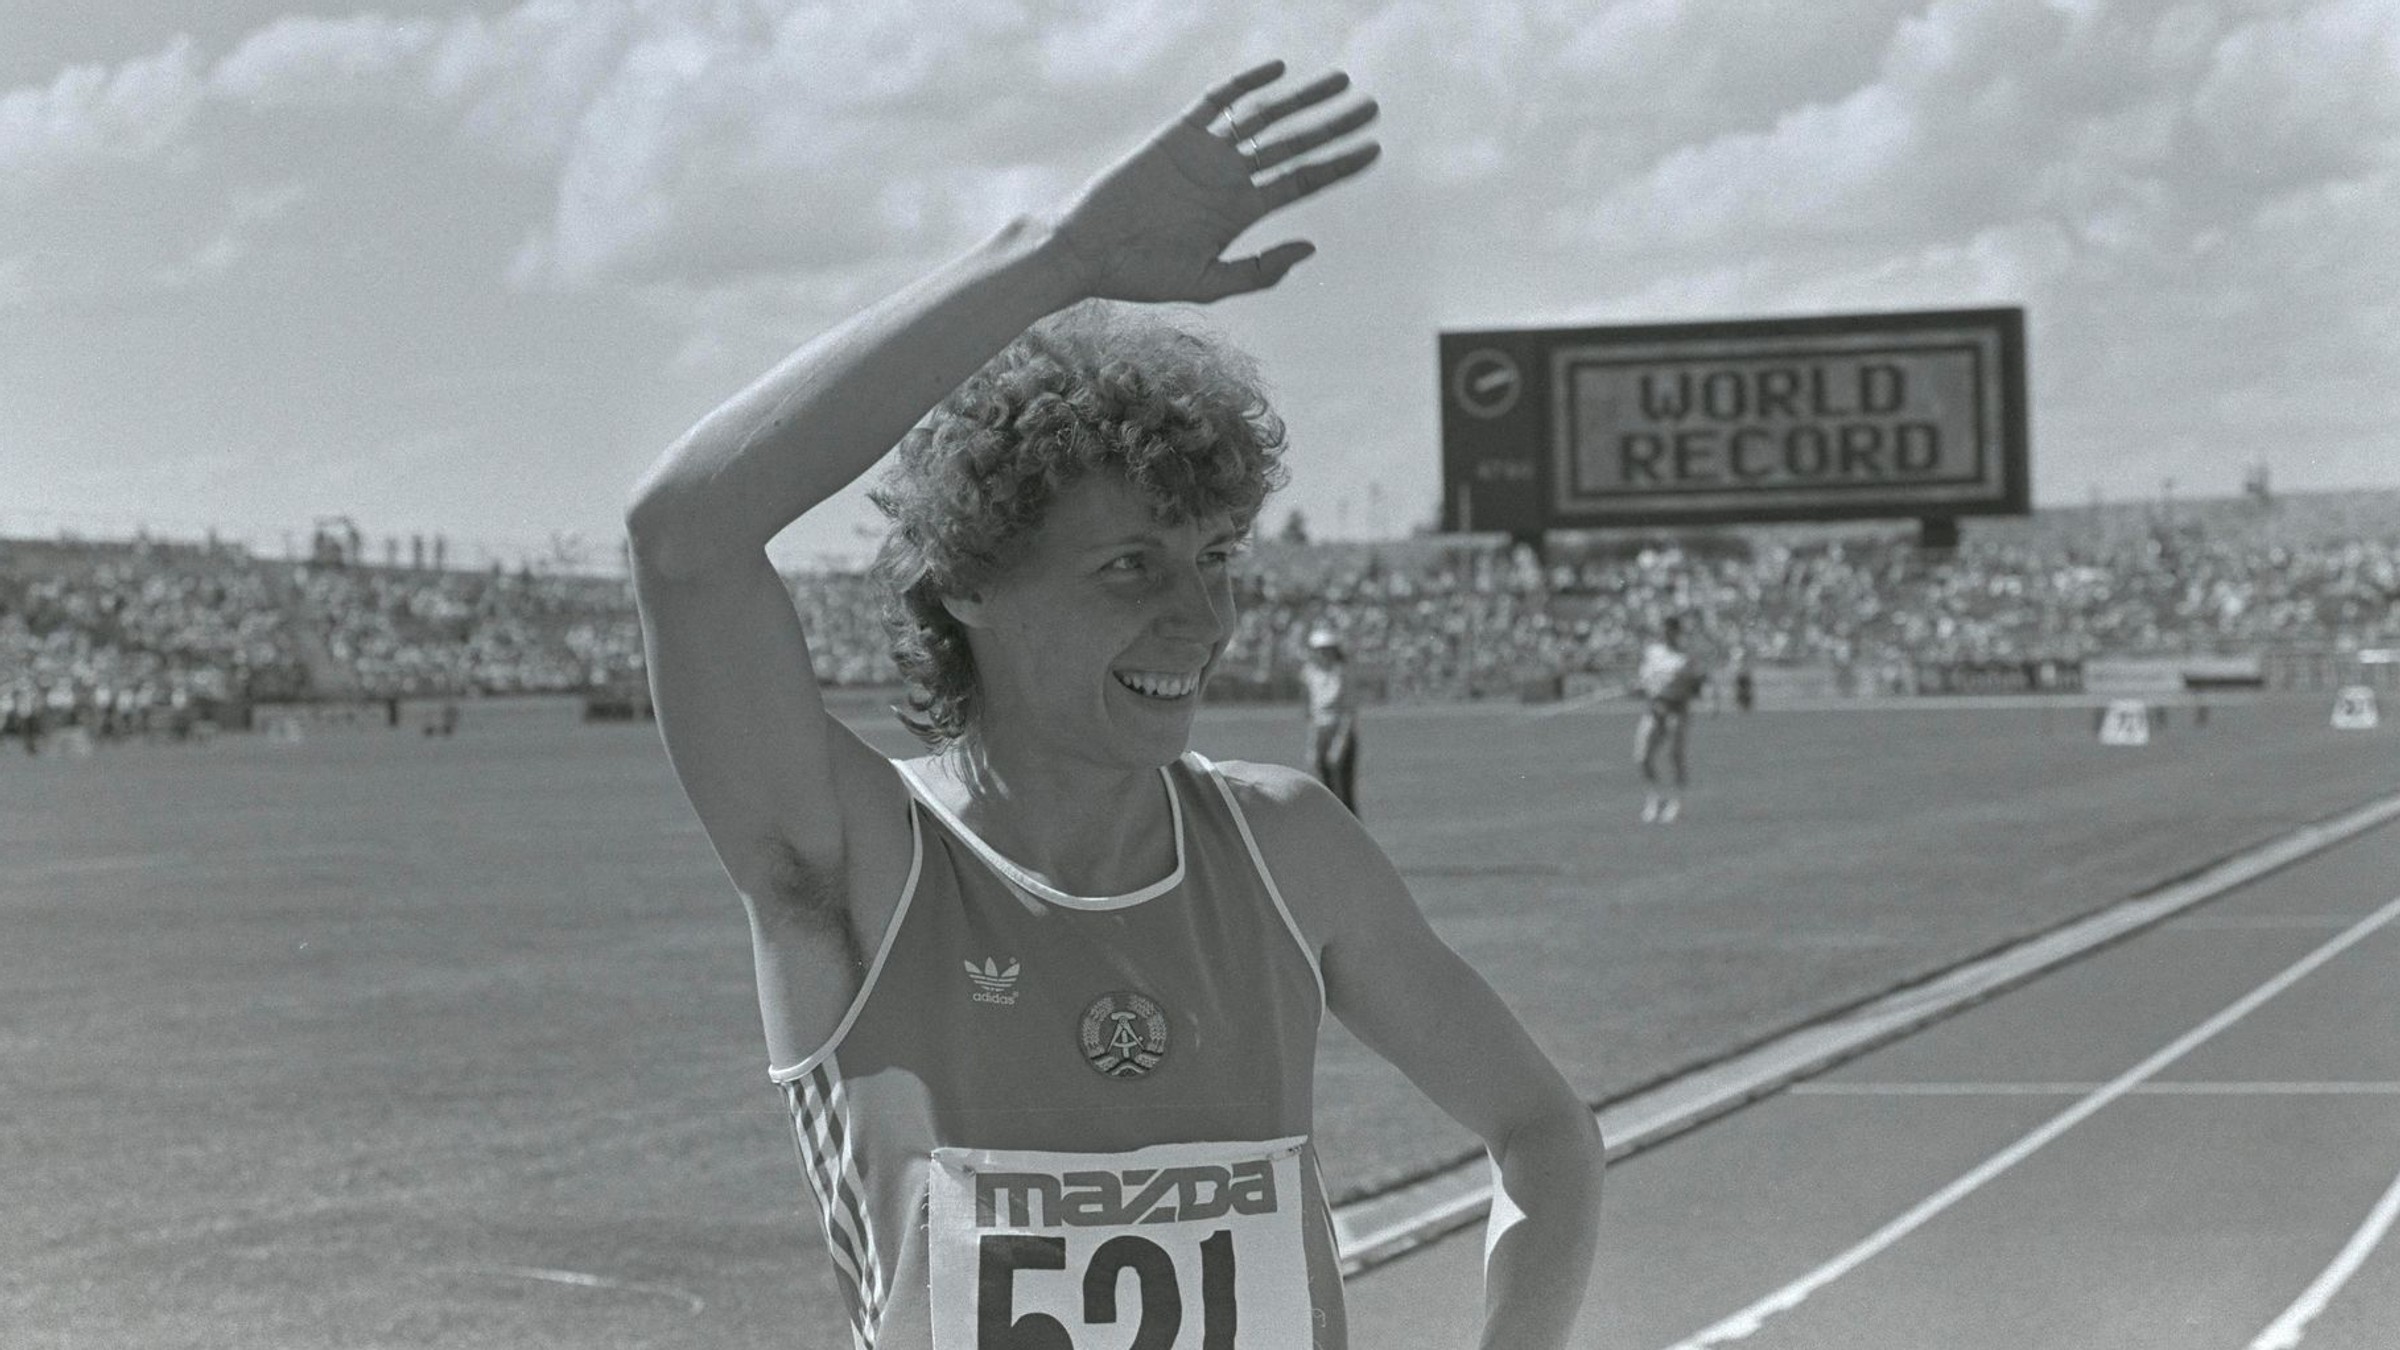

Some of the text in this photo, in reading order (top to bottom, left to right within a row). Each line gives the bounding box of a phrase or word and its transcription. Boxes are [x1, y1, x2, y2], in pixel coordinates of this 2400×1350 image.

[1639, 362, 1905, 422] WORLD
[1619, 421, 1939, 483] RECORD
[972, 990, 1016, 1006] adidas
[977, 1229, 1238, 1350] 521
